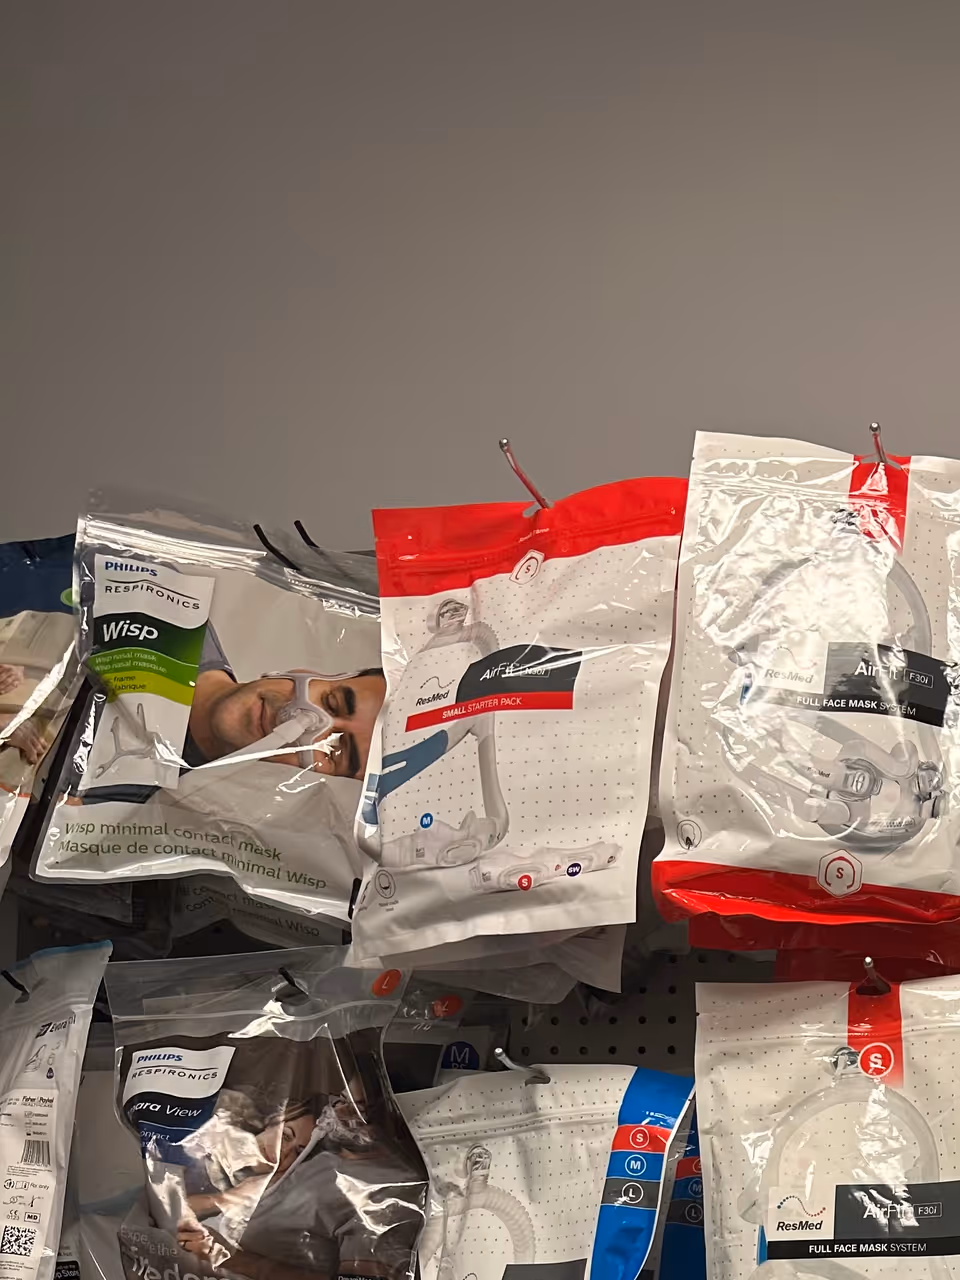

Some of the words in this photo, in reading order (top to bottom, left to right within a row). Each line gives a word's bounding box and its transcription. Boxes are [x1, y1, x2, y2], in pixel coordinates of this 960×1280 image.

[105, 561, 158, 577] PHILIPS
[524, 564, 531, 574] S
[105, 584, 200, 610] RESPIRONICS
[102, 620, 159, 642] Wisp
[113, 652, 132, 660] nasal
[134, 653, 157, 661] mask
[112, 660, 131, 669] nasal
[132, 661, 167, 673] masque
[854, 661, 898, 679] AirFit
[765, 668, 814, 685] ResMed
[416, 691, 450, 706] ResMed
[442, 706, 466, 719] SMALL
[467, 699, 499, 712] STARTER
[500, 697, 522, 707] PACK
[797, 696, 821, 706] FULL
[822, 698, 847, 708] FACE
[848, 699, 878, 710] MASK
[879, 702, 917, 716] SYSTEM
[65, 822, 95, 836] Wisp
[100, 822, 168, 835] minimal
[173, 827, 235, 847] contact
[238, 840, 281, 862] mask
[58, 841, 122, 856] Masque
[127, 840, 148, 854] de
[153, 843, 217, 857] contact
[222, 852, 281, 880] minimal
[285, 870, 327, 890] Wisp
[568, 865, 581, 873] SW
[835, 867, 844, 879] S
[522, 878, 528, 886] S
[136, 1054, 184, 1064] PHILIPS
[450, 1046, 469, 1063] M
[870, 1053, 882, 1066] S
[131, 1068, 218, 1081] RESPIRONICS
[165, 1104, 202, 1118] View
[636, 1133, 643, 1143] S
[630, 1160, 641, 1170] M
[629, 1188, 636, 1198] L
[918, 1205, 937, 1215] F30i
[776, 1220, 823, 1232] ResMed
[809, 1244, 831, 1253] FULL
[834, 1244, 857, 1253] FACE
[859, 1243, 888, 1252] MASK
[890, 1242, 927, 1252] SYSTEM
